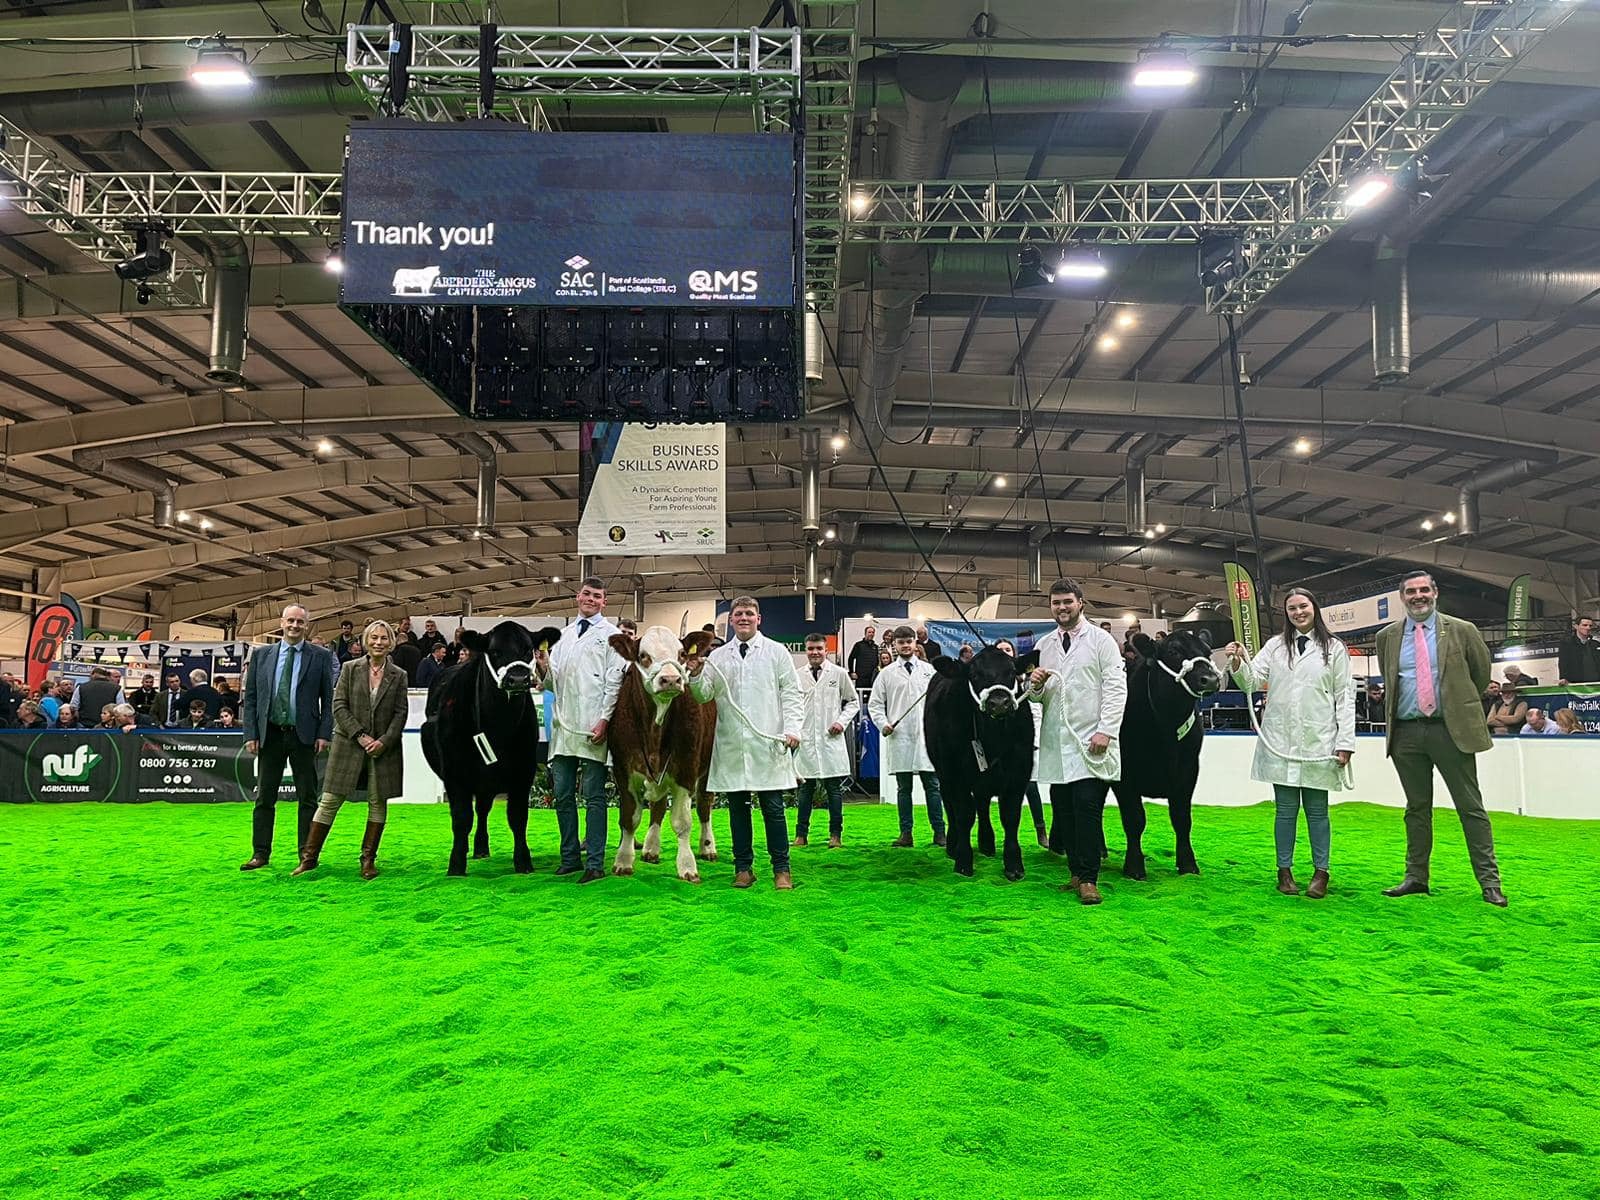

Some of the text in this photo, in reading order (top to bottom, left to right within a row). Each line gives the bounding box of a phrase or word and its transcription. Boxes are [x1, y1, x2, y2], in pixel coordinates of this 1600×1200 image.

[351, 220, 495, 251] Thank you!
[475, 269, 496, 278] THE
[433, 277, 537, 288] ABERDEEN-ANGUS
[560, 272, 595, 288] SAC
[688, 270, 758, 293] QMS
[483, 288, 522, 297] SOCIETY
[653, 445, 719, 456] BUSINESS
[618, 459, 719, 471] SKILLS AWARD
[640, 486, 671, 494] Dynamic
[673, 486, 718, 494] Competition
[663, 495, 692, 503] Aspiring
[695, 495, 718, 503] Young
[930, 625, 957, 635] Farm
[786, 642, 803, 651] XIT
[941, 640, 958, 648] ore
[177, 744, 197, 752] better
[197, 744, 218, 752] future
[42, 744, 92, 776] nwf
[139, 758, 216, 768] 0800 756 2787
